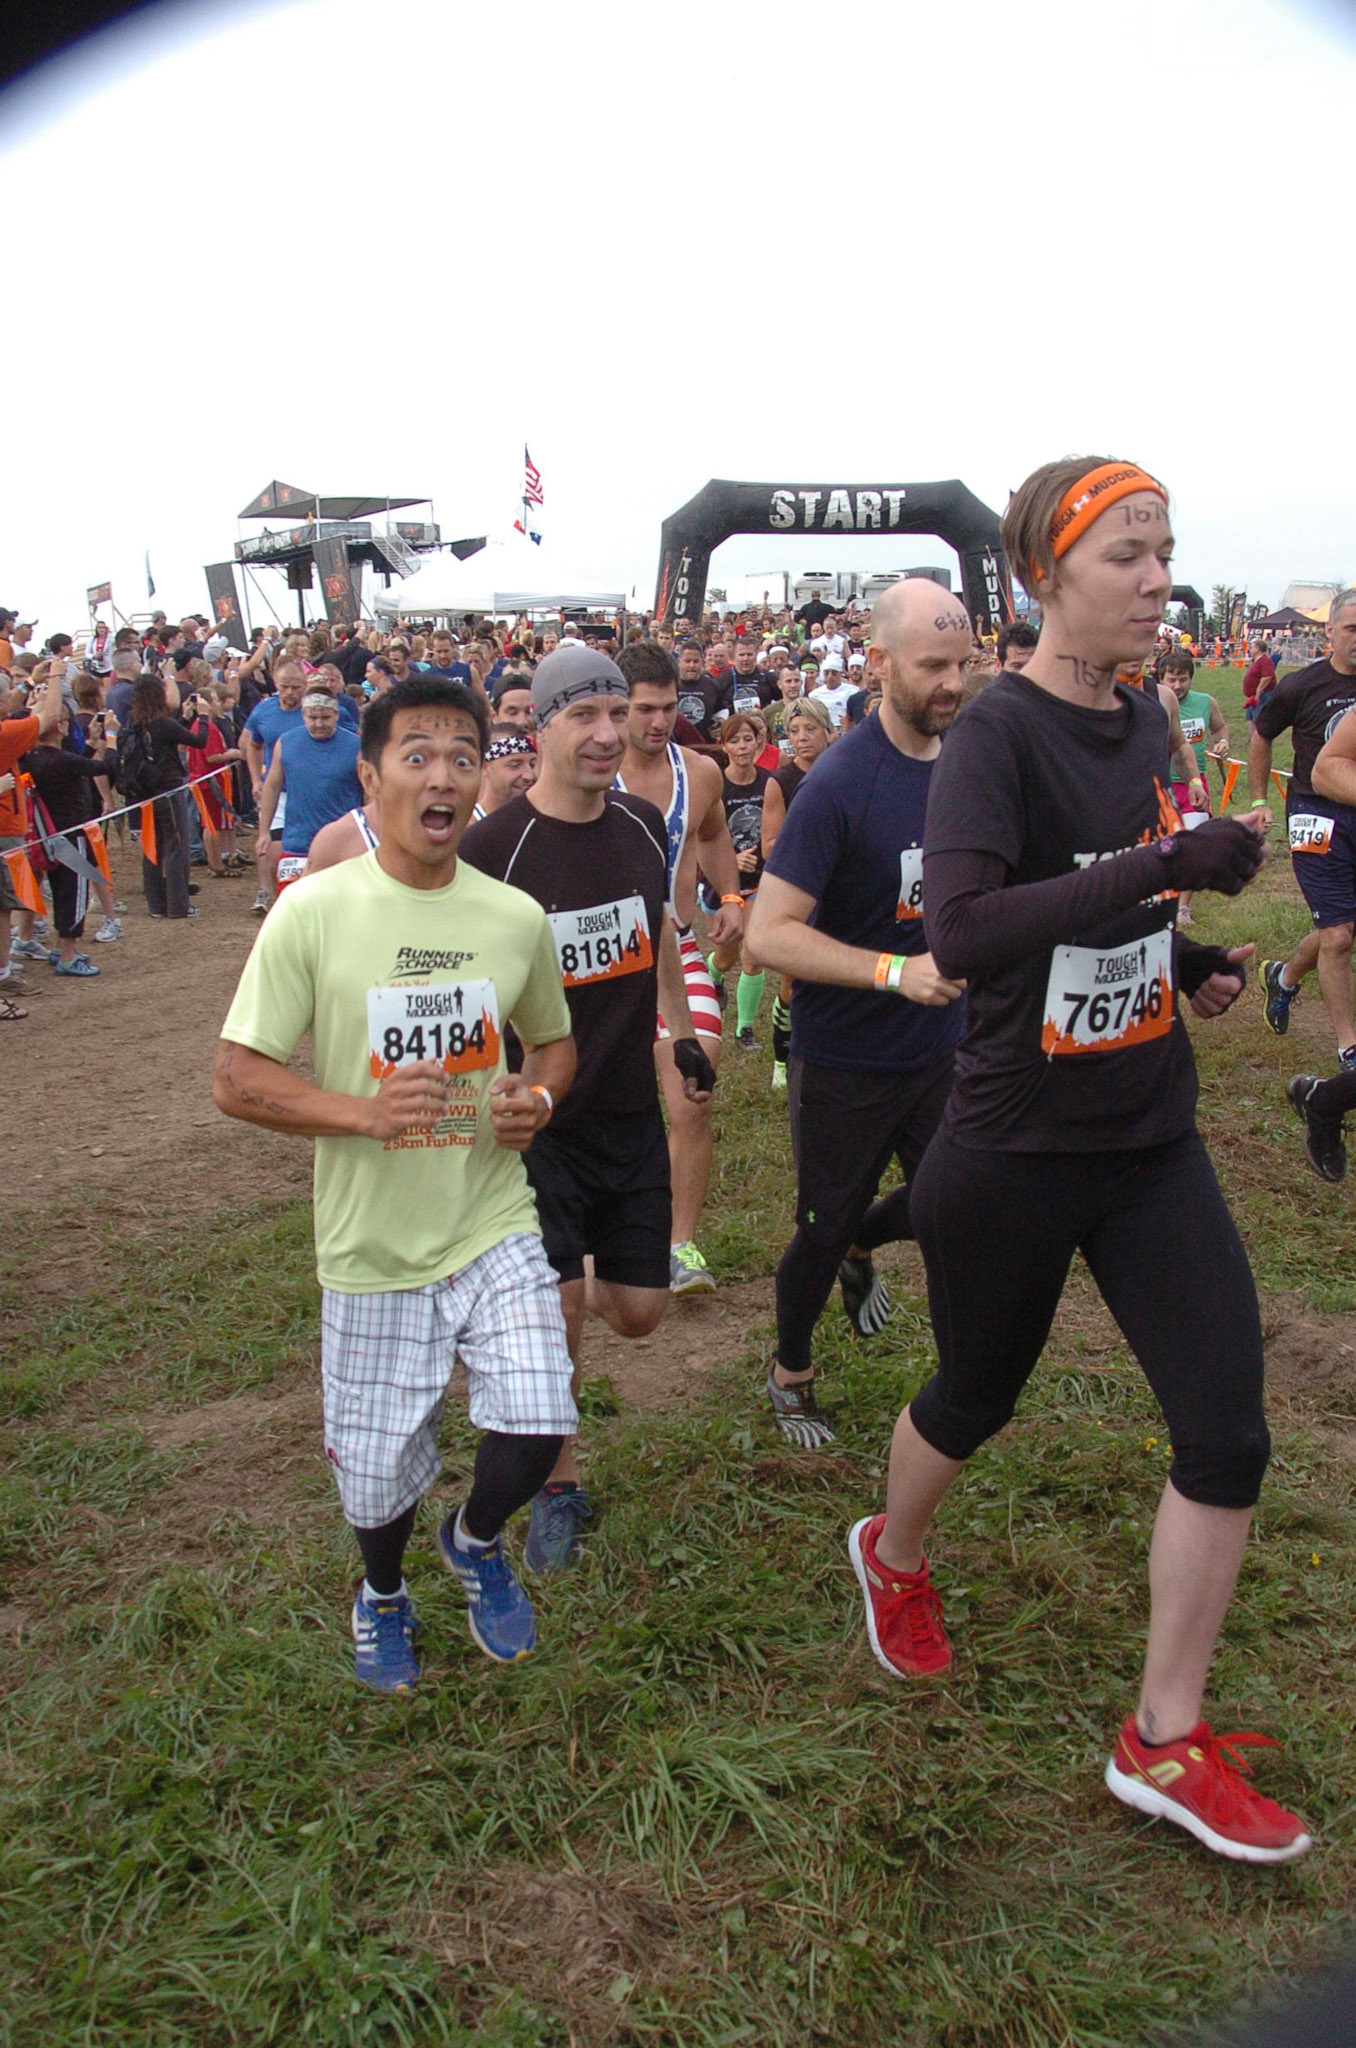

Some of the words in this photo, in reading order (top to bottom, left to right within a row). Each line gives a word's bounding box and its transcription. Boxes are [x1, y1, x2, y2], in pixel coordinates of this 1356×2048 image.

[1089, 469, 1139, 499] MUDDER
[769, 489, 906, 529] START
[674, 556, 693, 629] TOU
[576, 911, 612, 928] TOUGH
[405, 958, 462, 970] CHOICE
[561, 929, 640, 973] 81814
[1096, 951, 1139, 974] TOUGH
[1094, 967, 1139, 985] MUDDER
[406, 993, 453, 1009] TOUGH
[406, 1005, 453, 1019] MUDDER
[1063, 977, 1162, 1034] 76746
[383, 1019, 486, 1063] 84184
